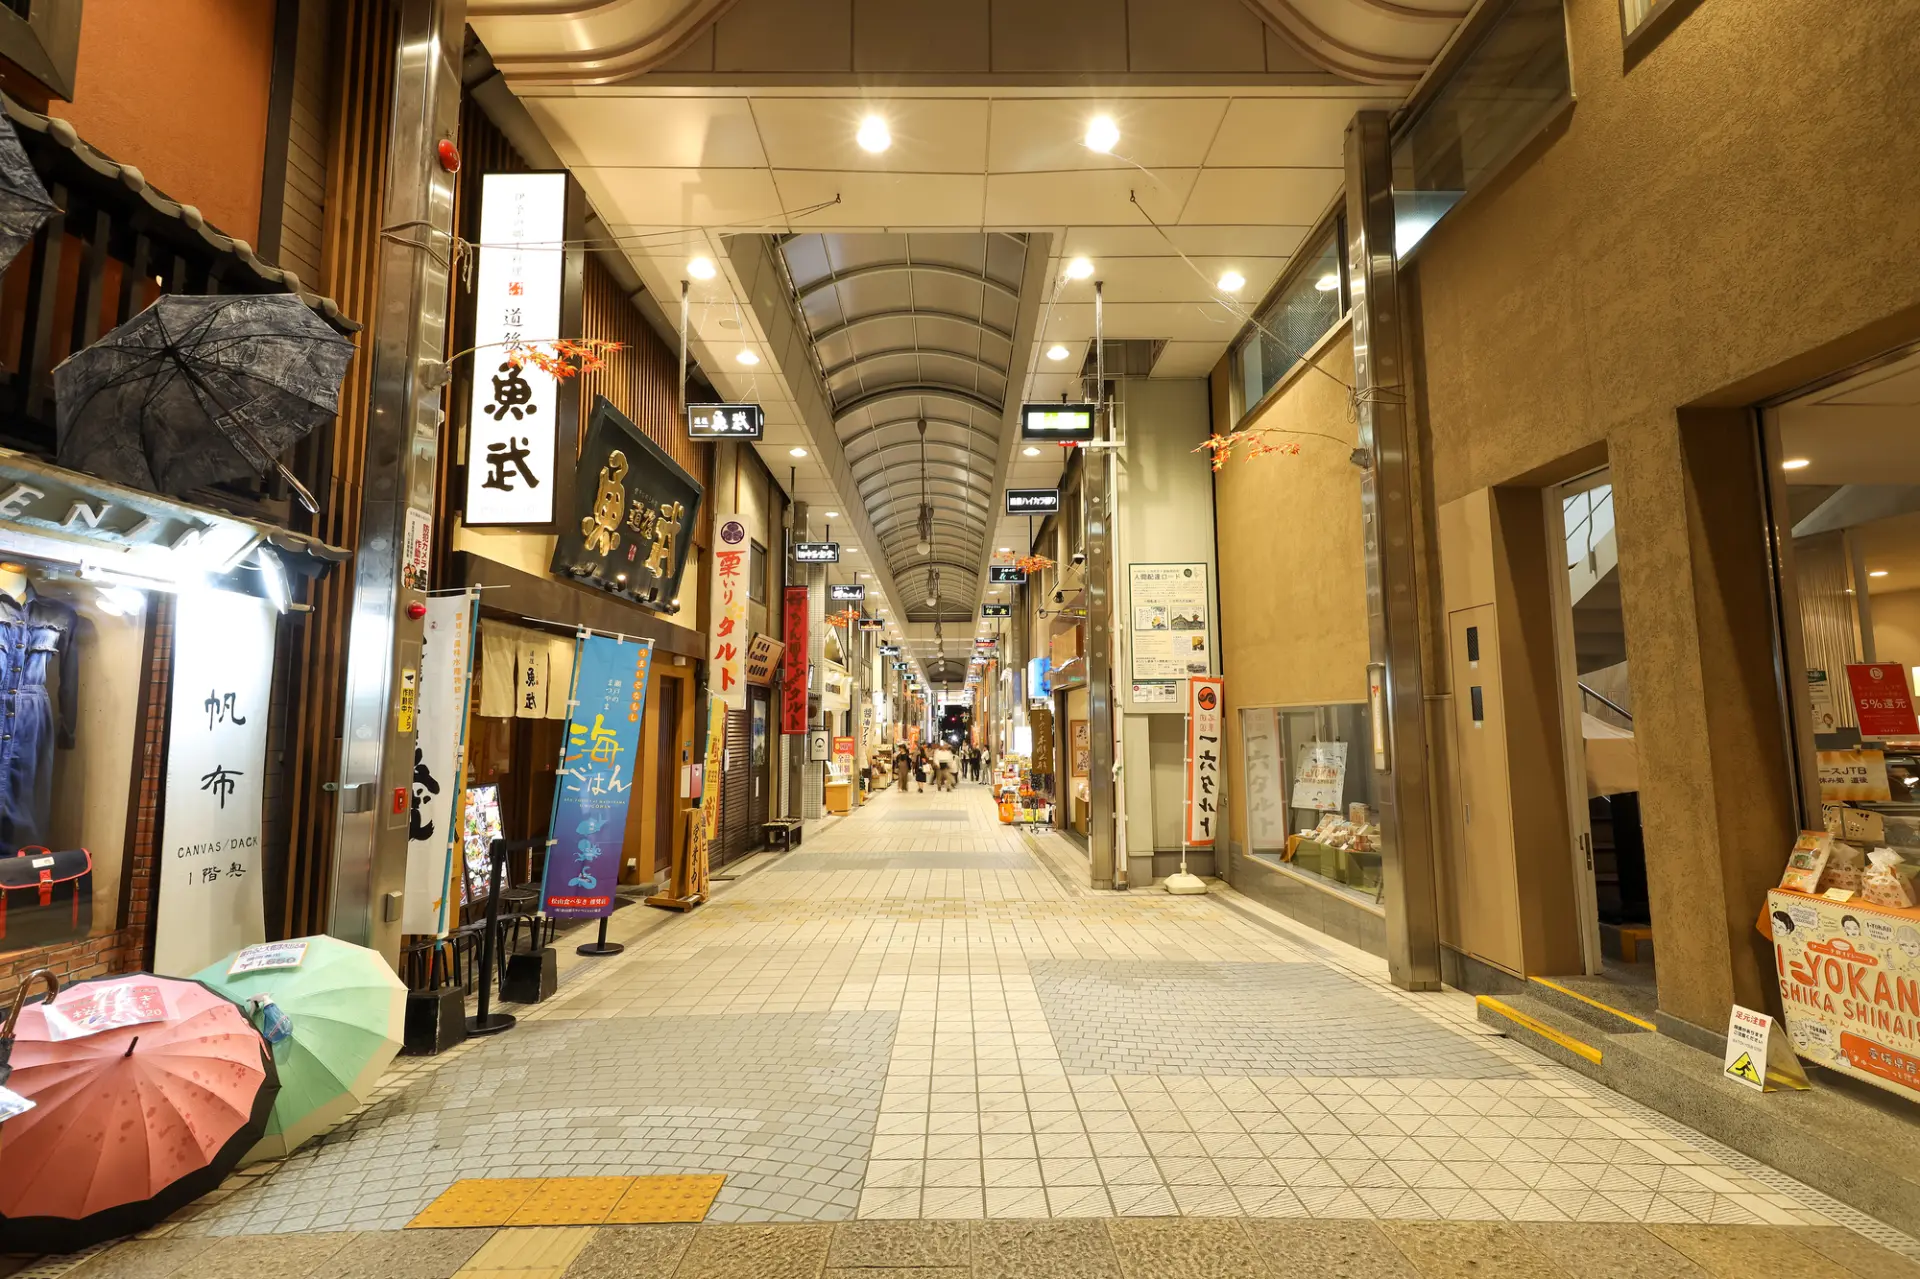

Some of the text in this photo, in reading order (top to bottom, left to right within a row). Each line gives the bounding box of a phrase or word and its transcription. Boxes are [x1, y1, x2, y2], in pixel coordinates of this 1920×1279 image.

[503, 308, 523, 350] 道後
[481, 362, 540, 492] 魚武
[714, 550, 746, 692] 栗いりタルト
[524, 667, 537, 710] 魚武
[629, 649, 647, 721] うまいぞなもし
[201, 689, 247, 810] 帆布
[565, 714, 625, 769] 海
[566, 763, 633, 796] ごはん
[177, 836, 258, 859] CANVAS/DACK
[1780, 979, 1836, 1015] SHIKA
[1868, 1047, 1920, 1075] 愛媛県産
